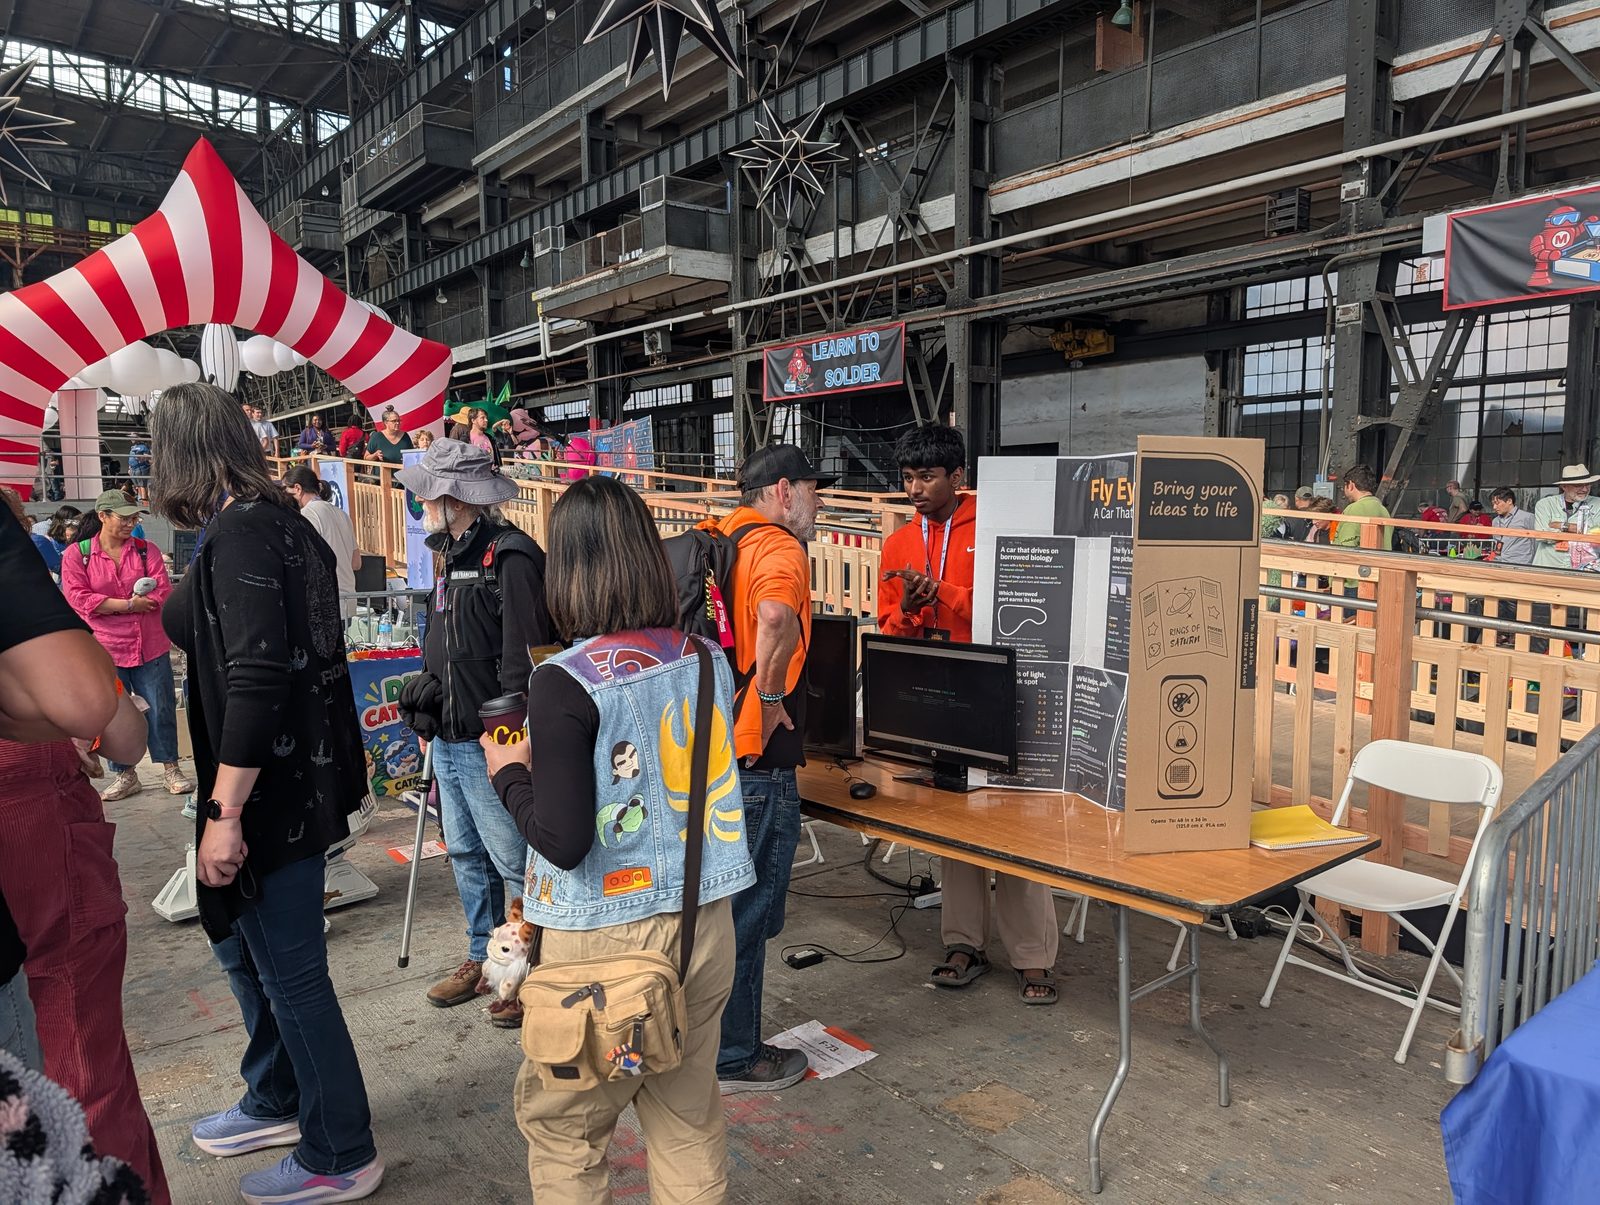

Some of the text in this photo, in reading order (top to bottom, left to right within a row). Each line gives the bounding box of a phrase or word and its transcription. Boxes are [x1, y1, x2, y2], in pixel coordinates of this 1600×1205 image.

[1555, 234, 1568, 245] M
[812, 332, 880, 362] LEARN TO
[824, 362, 881, 388] SOLDER
[1091, 477, 1114, 507] Fly
[1153, 480, 1238, 500] Bring your
[1093, 506, 1133, 519] A Car That
[1149, 500, 1238, 518] ideas to life
[1000, 553, 1053, 562] borrowed biology
[1169, 623, 1200, 636] RINGS OF
[1169, 635, 1200, 647] SATURN
[1030, 671, 1047, 679] light,
[818, 1040, 839, 1052] F-73
